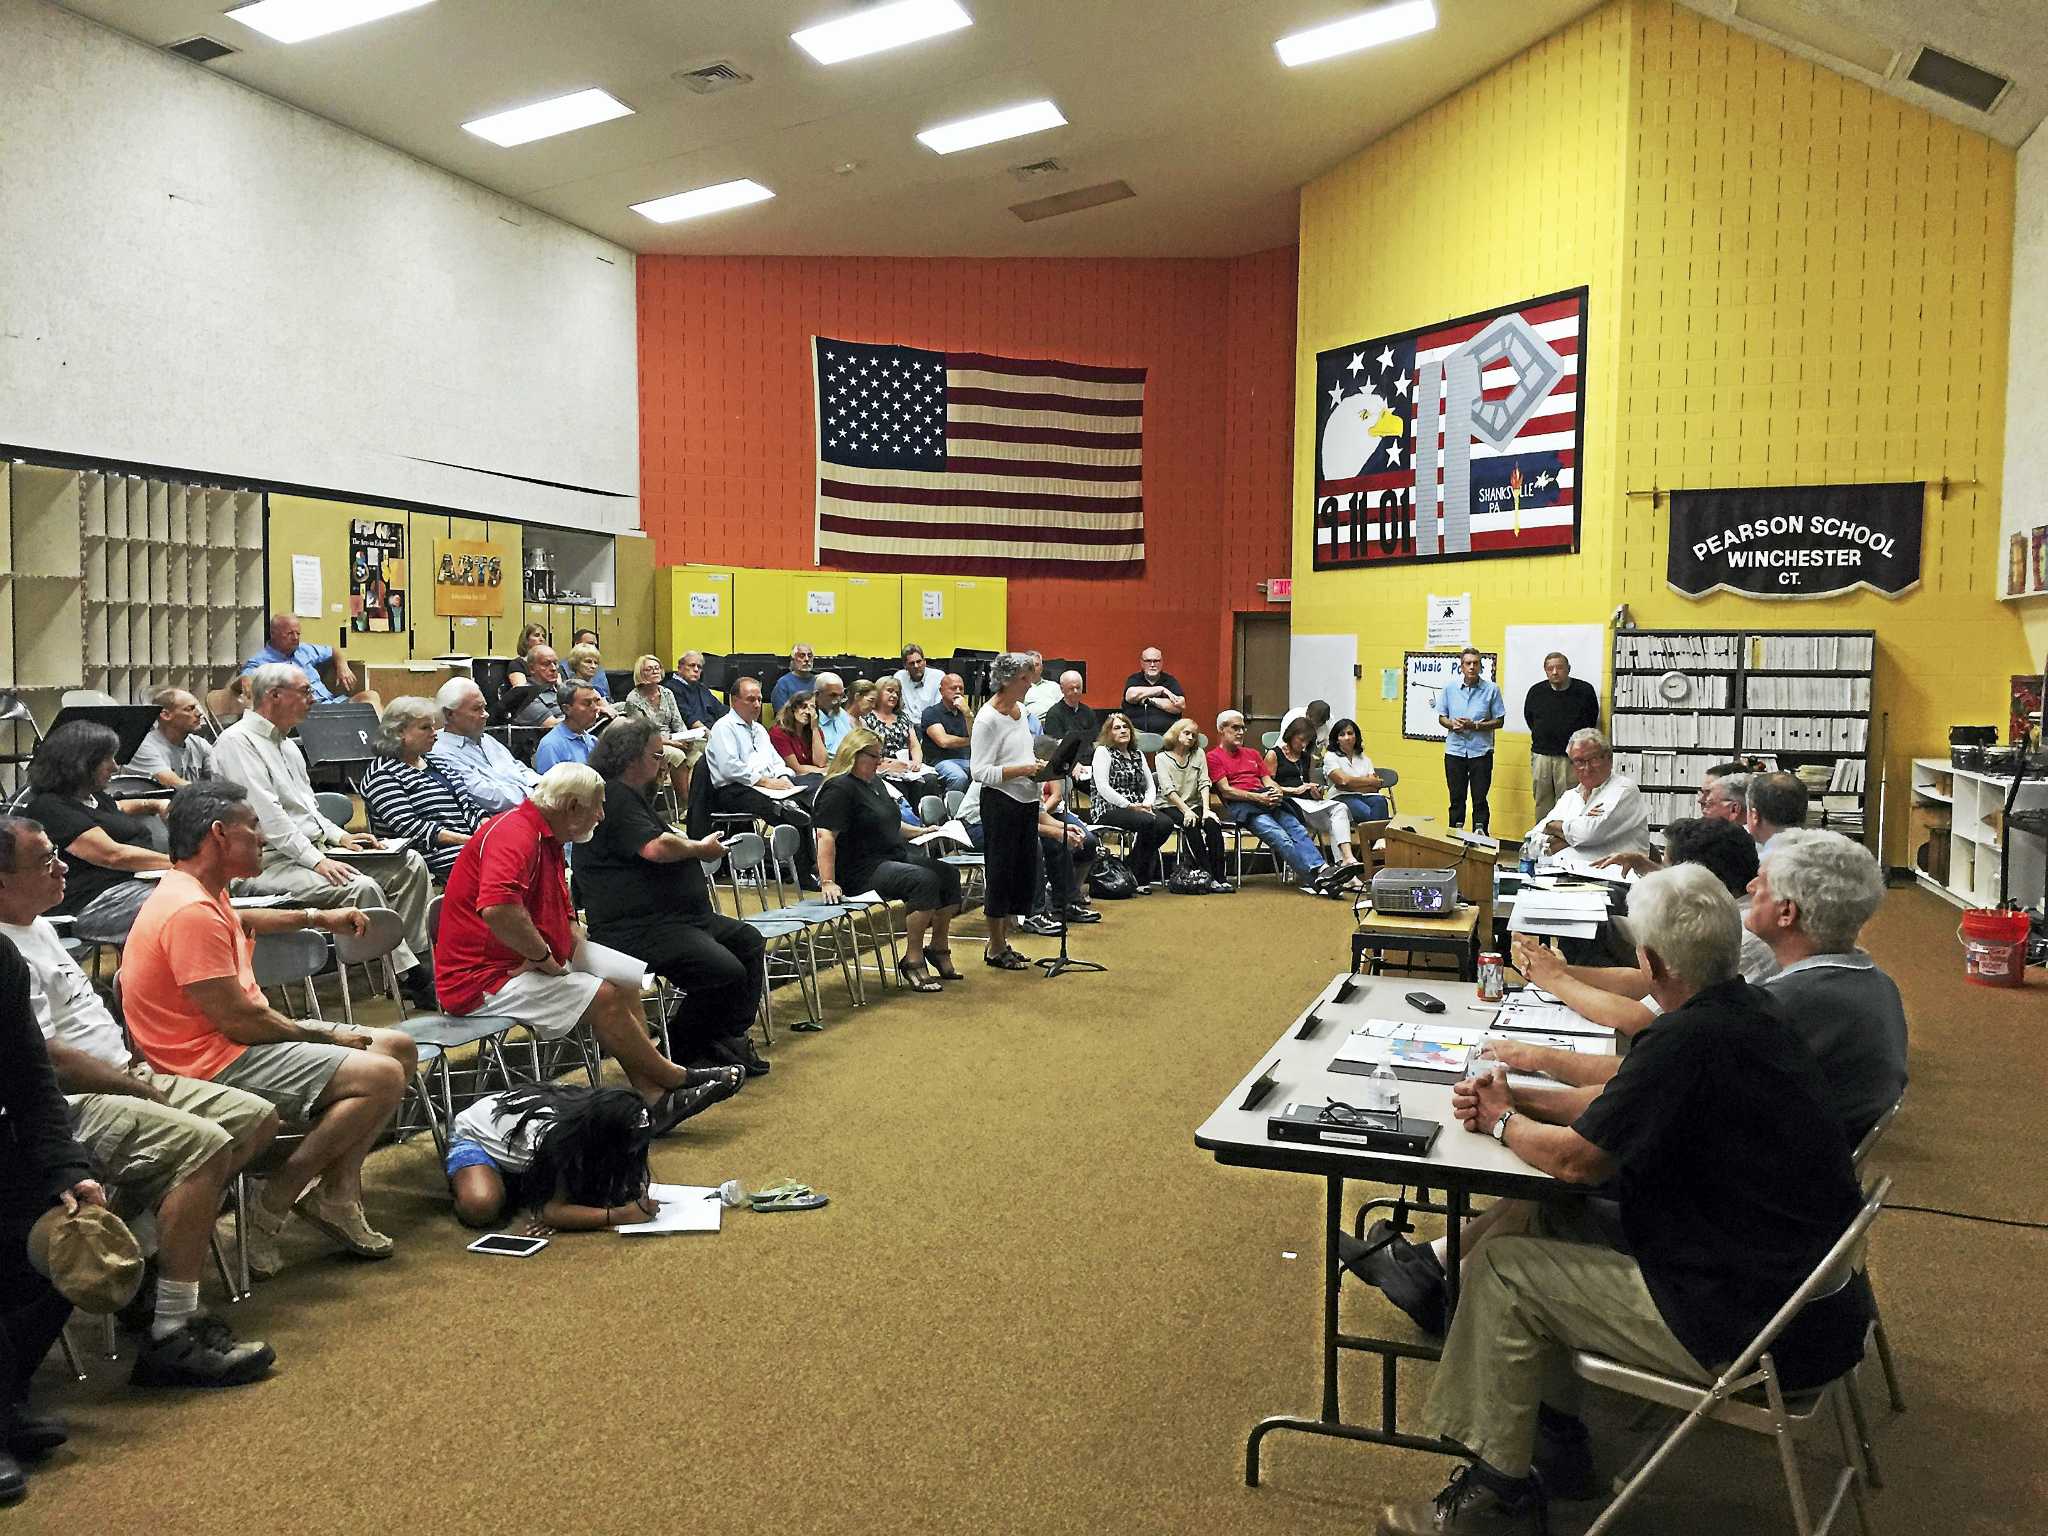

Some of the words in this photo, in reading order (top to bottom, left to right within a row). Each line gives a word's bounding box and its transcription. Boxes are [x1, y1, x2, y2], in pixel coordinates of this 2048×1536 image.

[1479, 483, 1534, 502] SHANKSVLLE
[1693, 515, 1803, 561] PEARSON
[1810, 516, 1895, 559] SCHOOL
[1727, 549, 1861, 568] WINCHESTER
[437, 553, 501, 587] ARTS
[1778, 571, 1801, 585] CT.
[1414, 660, 1441, 674] Music
